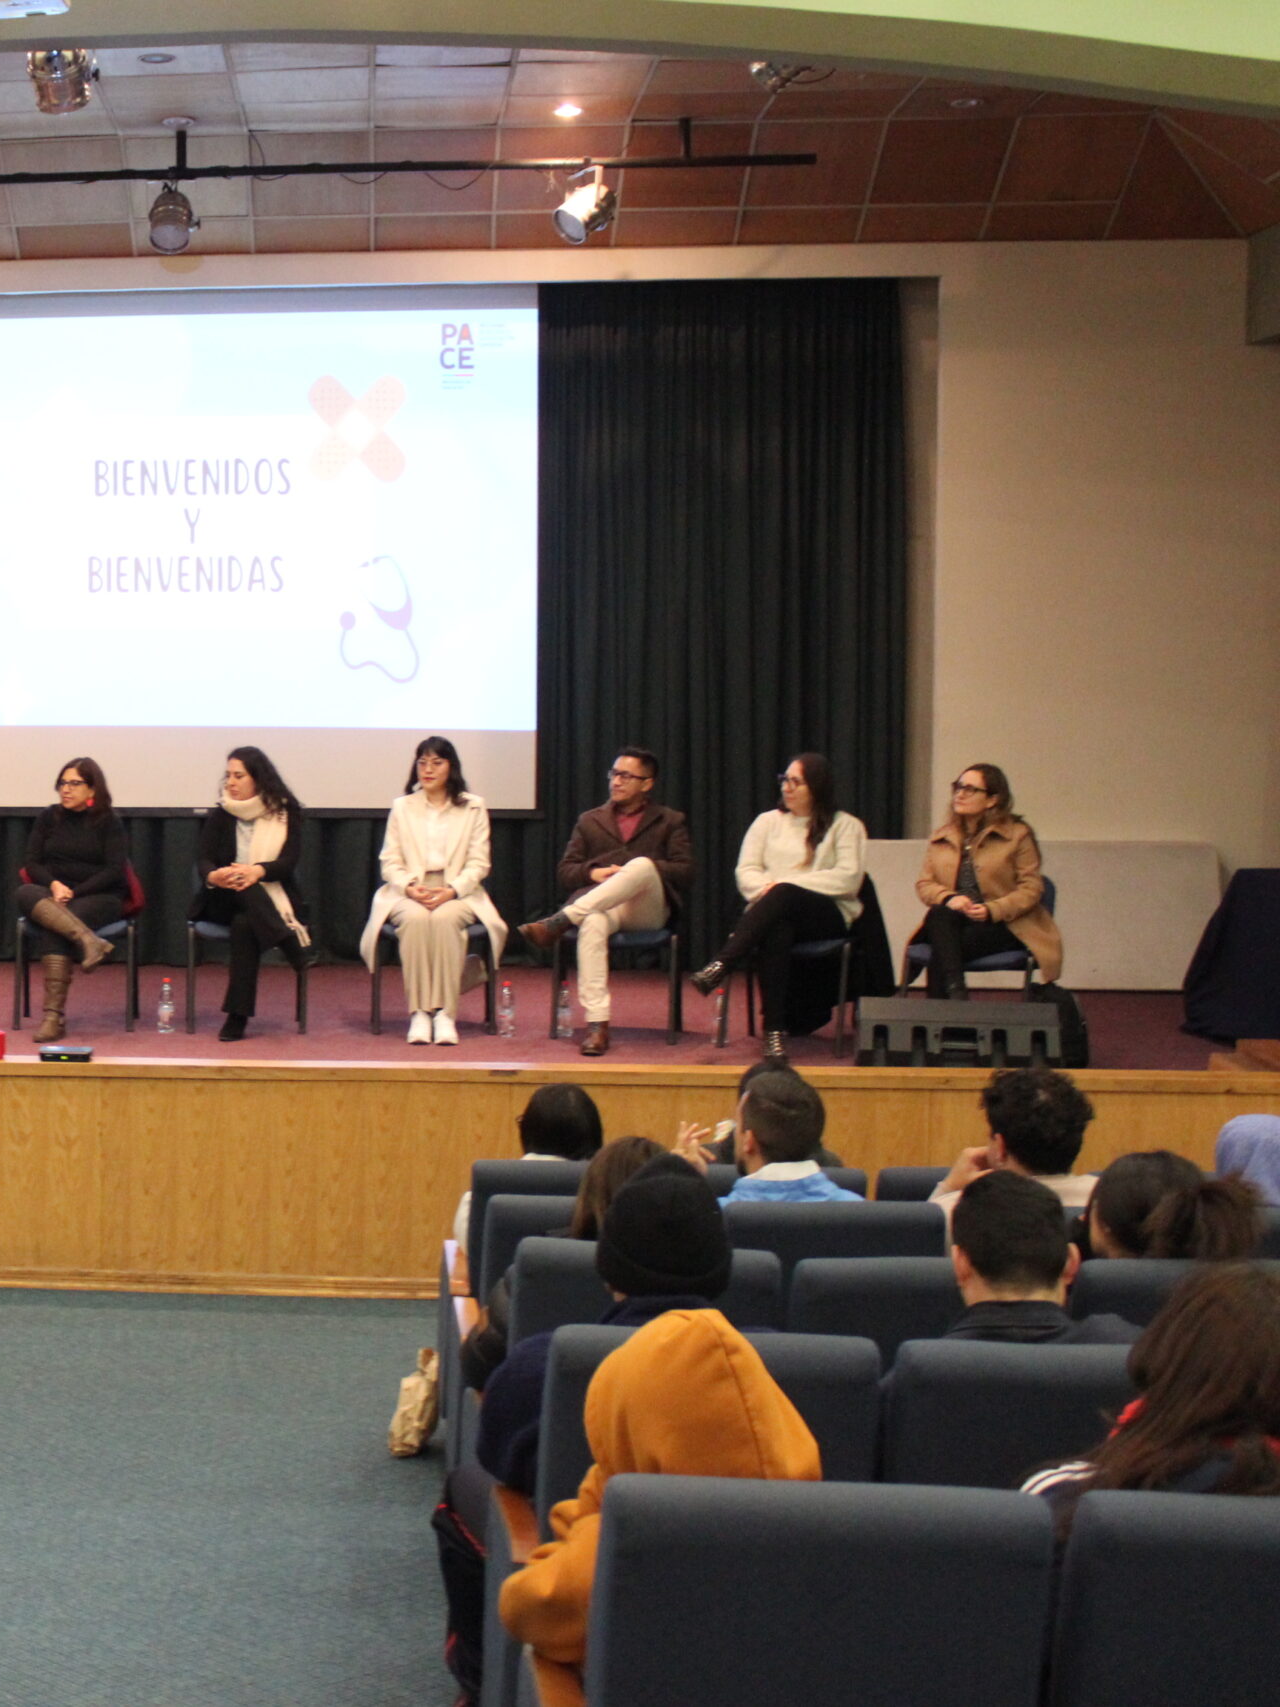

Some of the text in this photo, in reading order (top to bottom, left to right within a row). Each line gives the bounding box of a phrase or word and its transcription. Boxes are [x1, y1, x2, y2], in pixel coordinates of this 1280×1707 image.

[441, 323, 474, 345] PA
[439, 347, 475, 369] CE
[94, 458, 291, 496] BIENVENIDOS
[183, 508, 201, 544] Y
[87, 555, 285, 593] BIENVENIDAS
